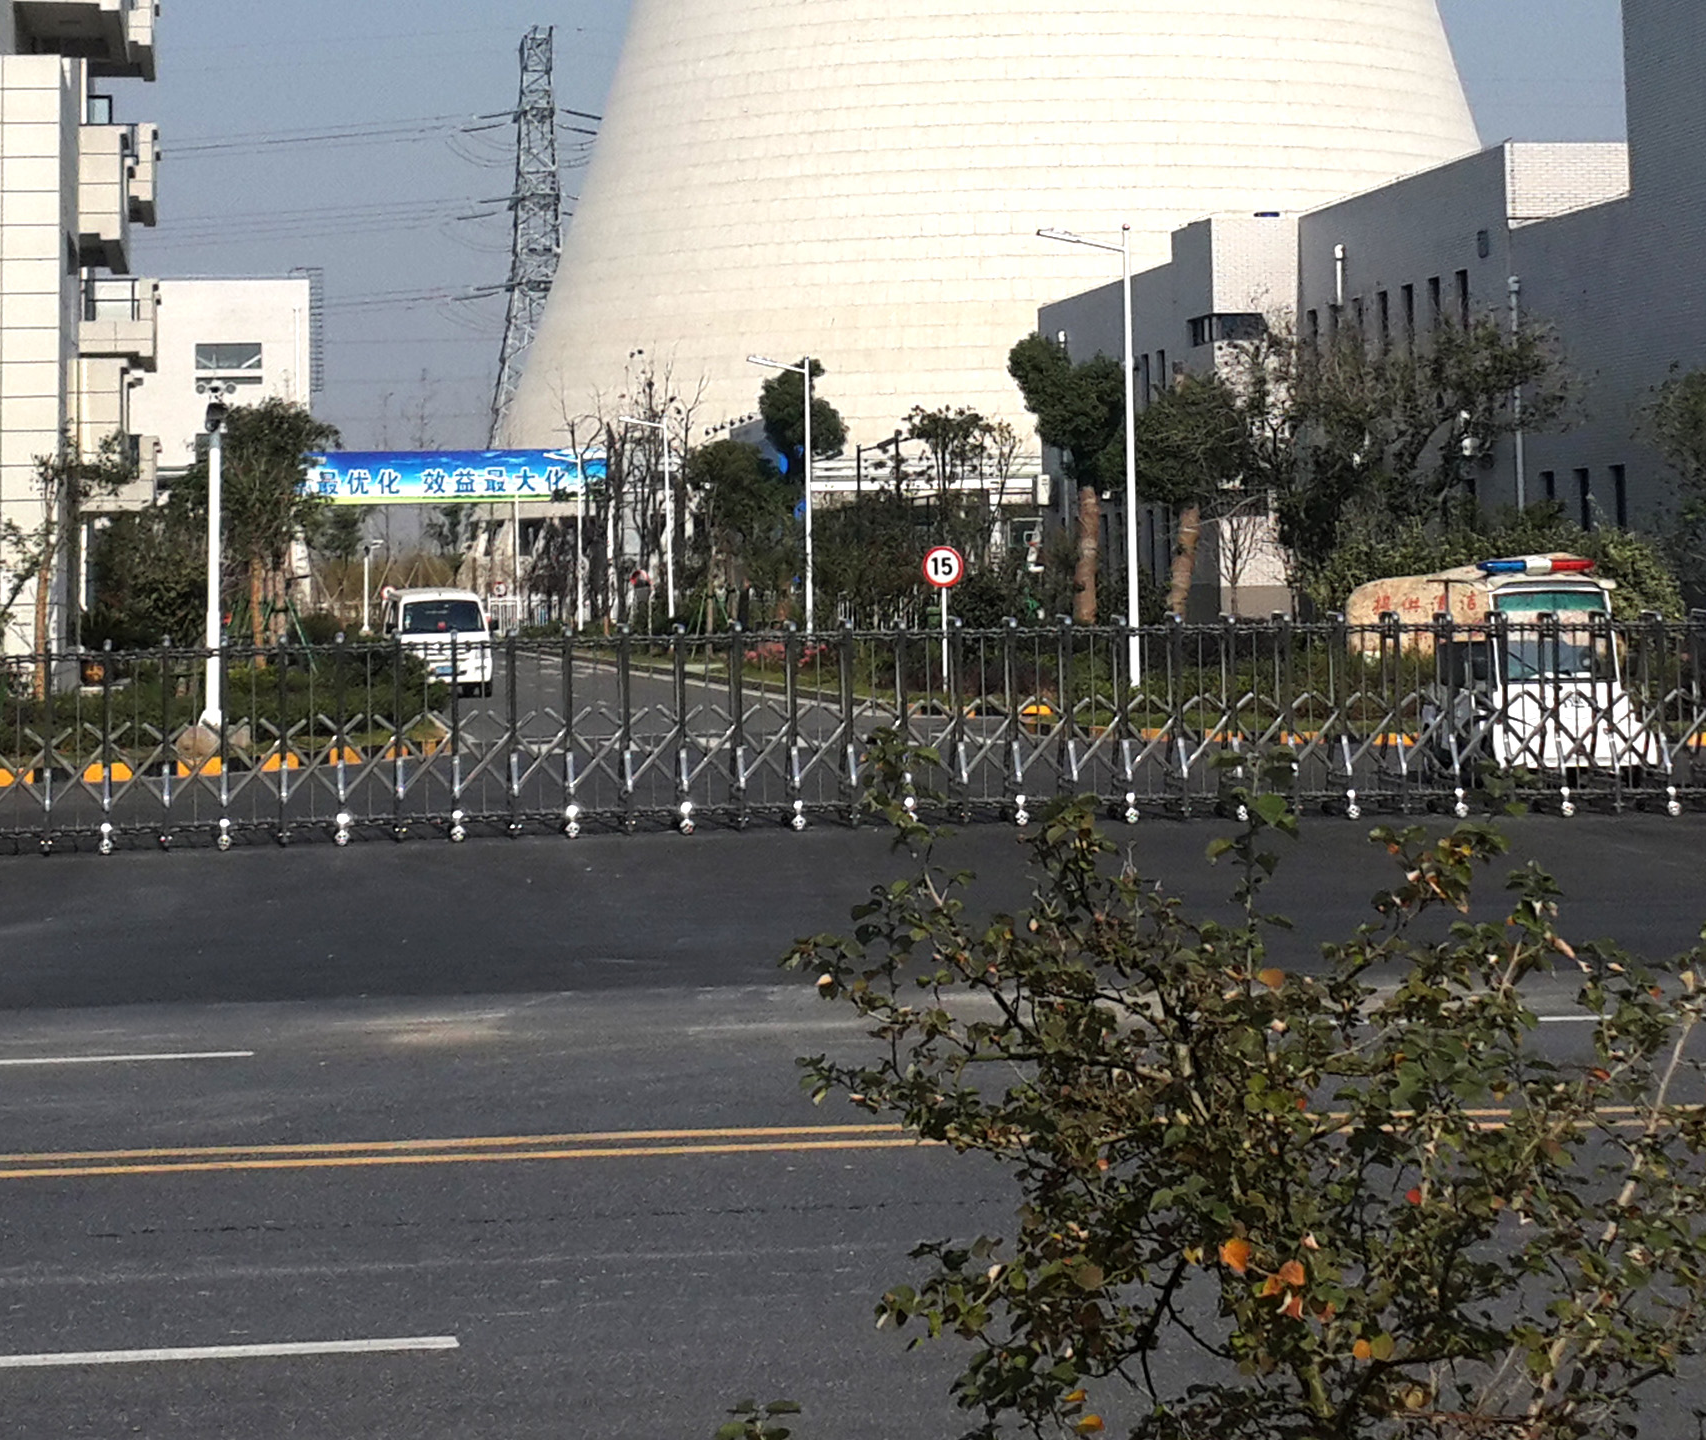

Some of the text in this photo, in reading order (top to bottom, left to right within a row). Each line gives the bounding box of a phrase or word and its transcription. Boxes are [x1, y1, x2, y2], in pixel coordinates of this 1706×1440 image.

[423, 469, 568, 493] 效益最大化
[931, 557, 953, 576] 15
